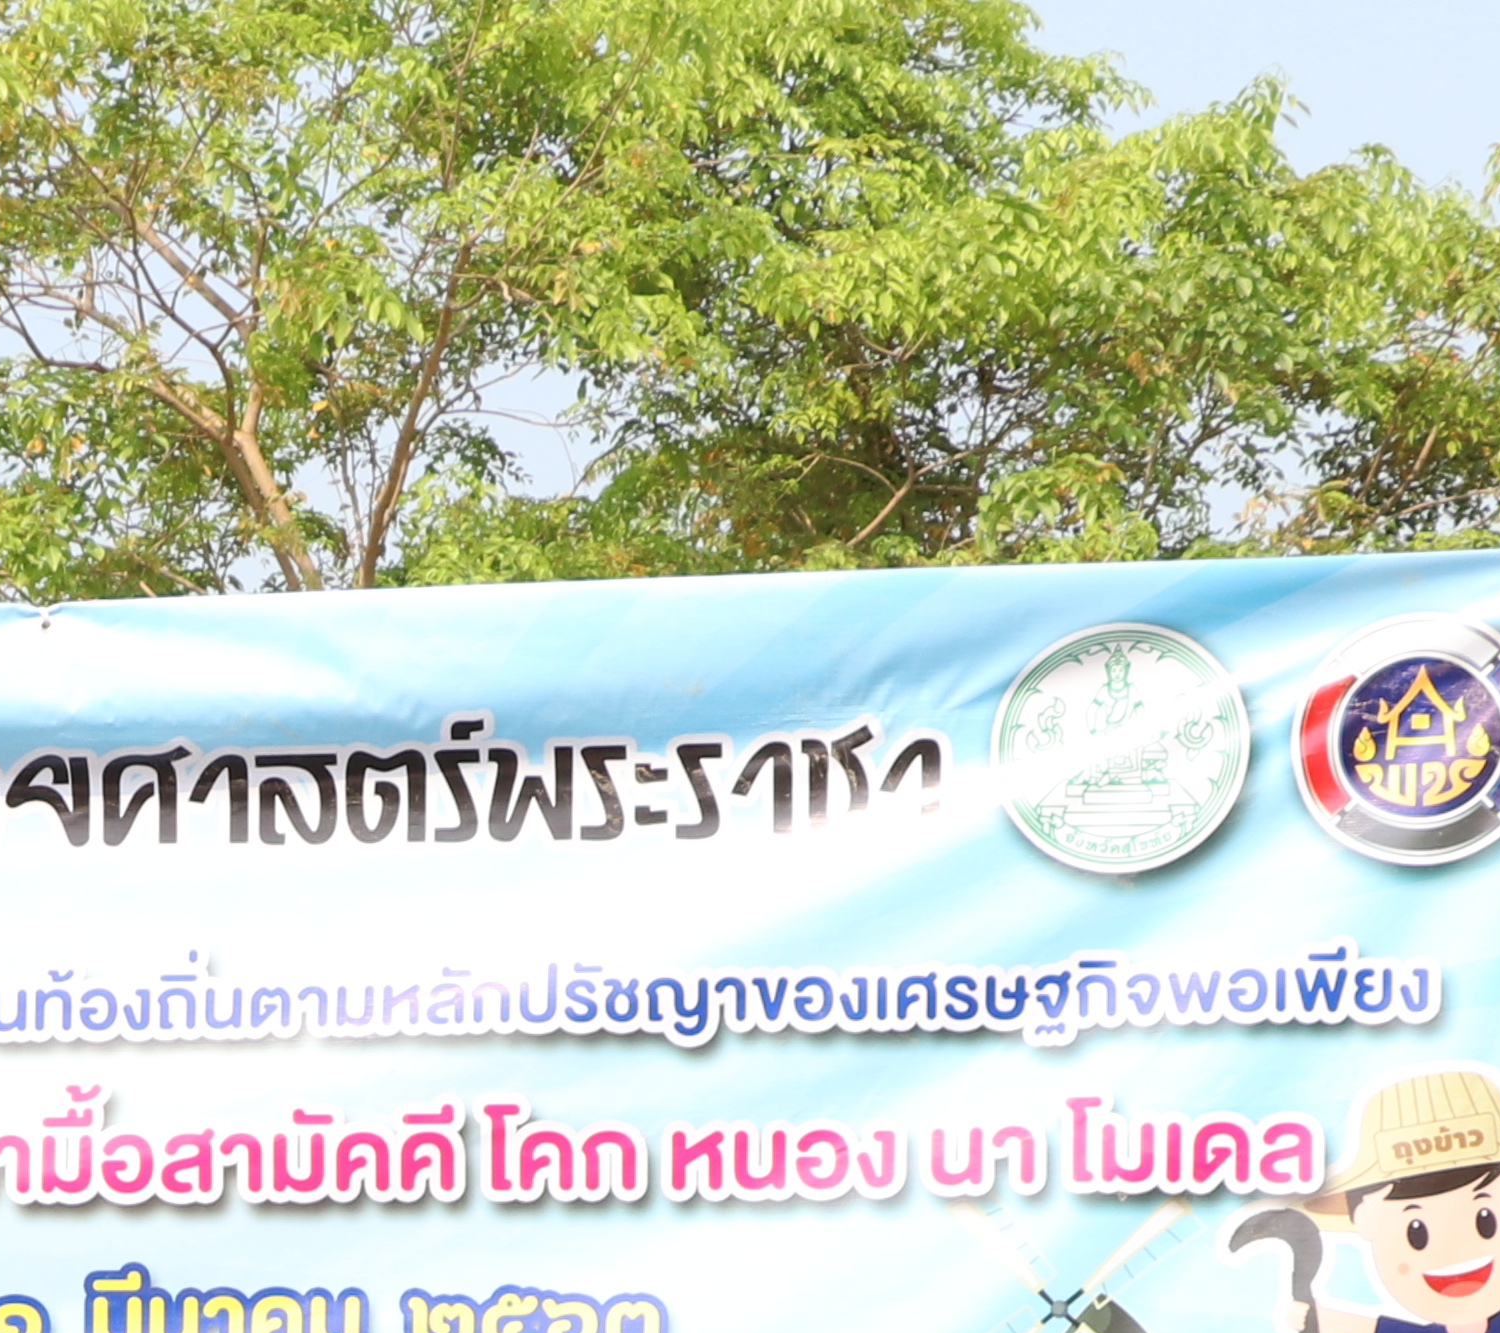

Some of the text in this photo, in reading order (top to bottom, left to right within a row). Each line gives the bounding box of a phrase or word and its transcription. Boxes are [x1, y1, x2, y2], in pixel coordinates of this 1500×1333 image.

[484, 1102, 637, 1194] โคก
[671, 1122, 897, 1192] หนอง
[931, 1124, 1035, 1188] นา
[1066, 1097, 1314, 1188] โมเดล
